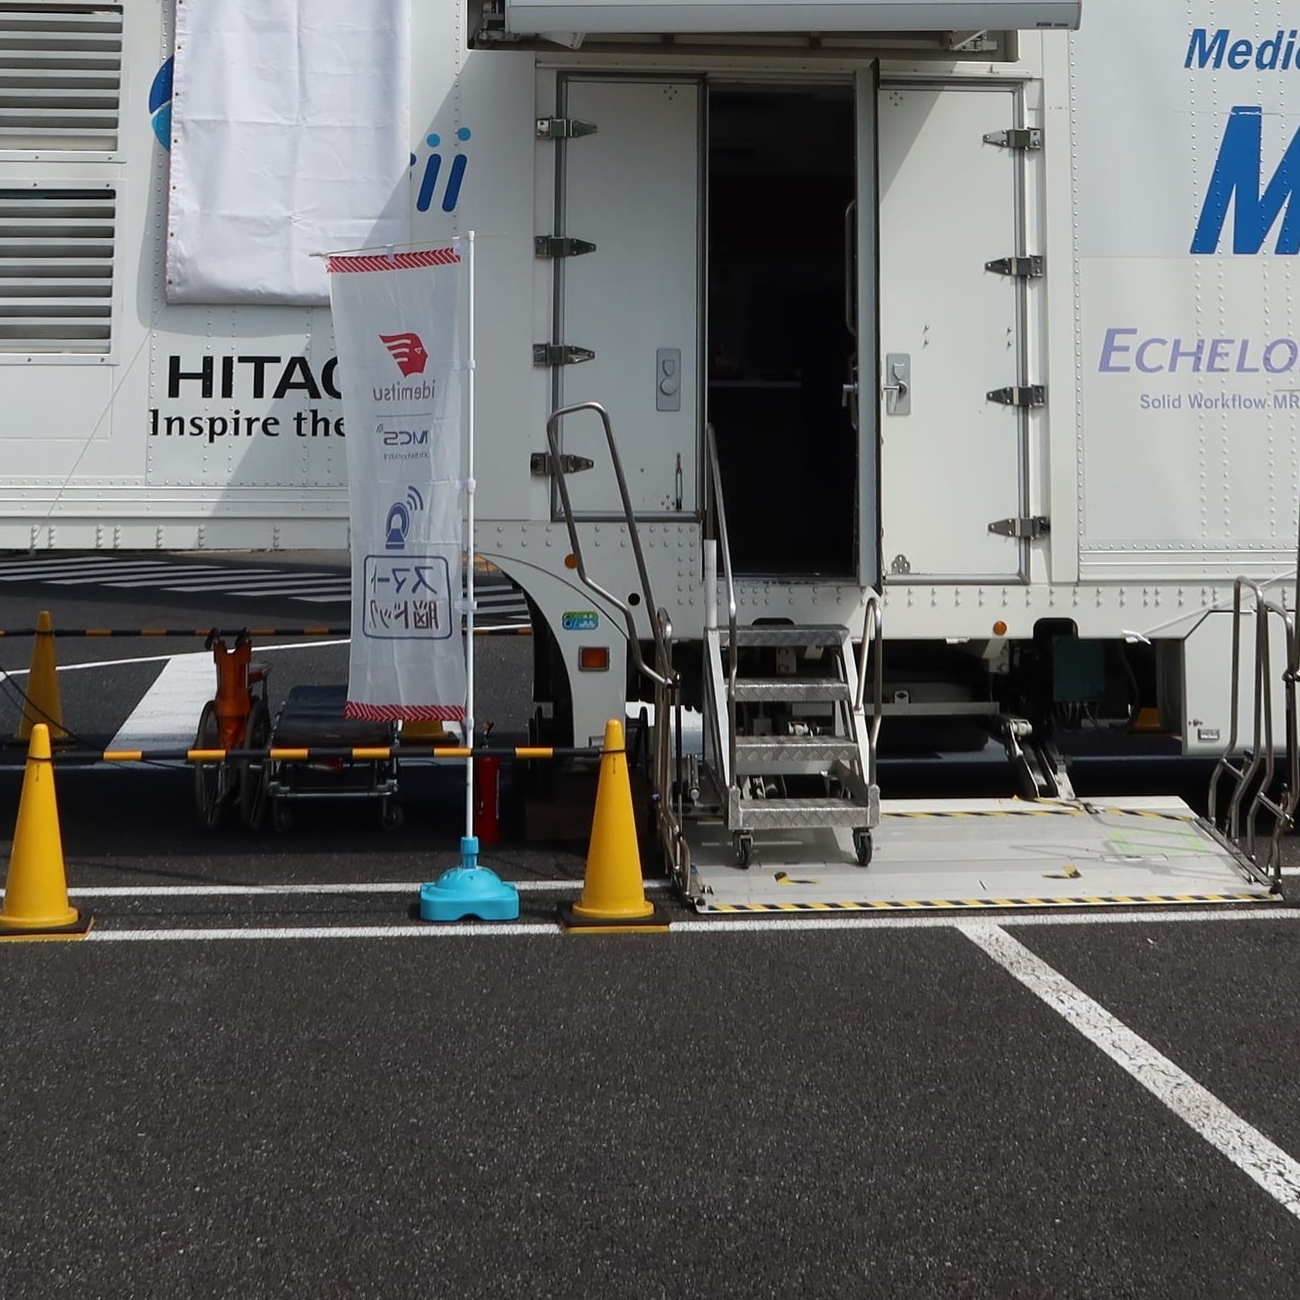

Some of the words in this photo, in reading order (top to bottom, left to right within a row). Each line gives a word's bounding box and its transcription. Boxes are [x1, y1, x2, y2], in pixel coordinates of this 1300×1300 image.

[1140, 393, 1182, 409] Solid
[1188, 392, 1268, 409] Workflow
[150, 409, 281, 442] Inspire
